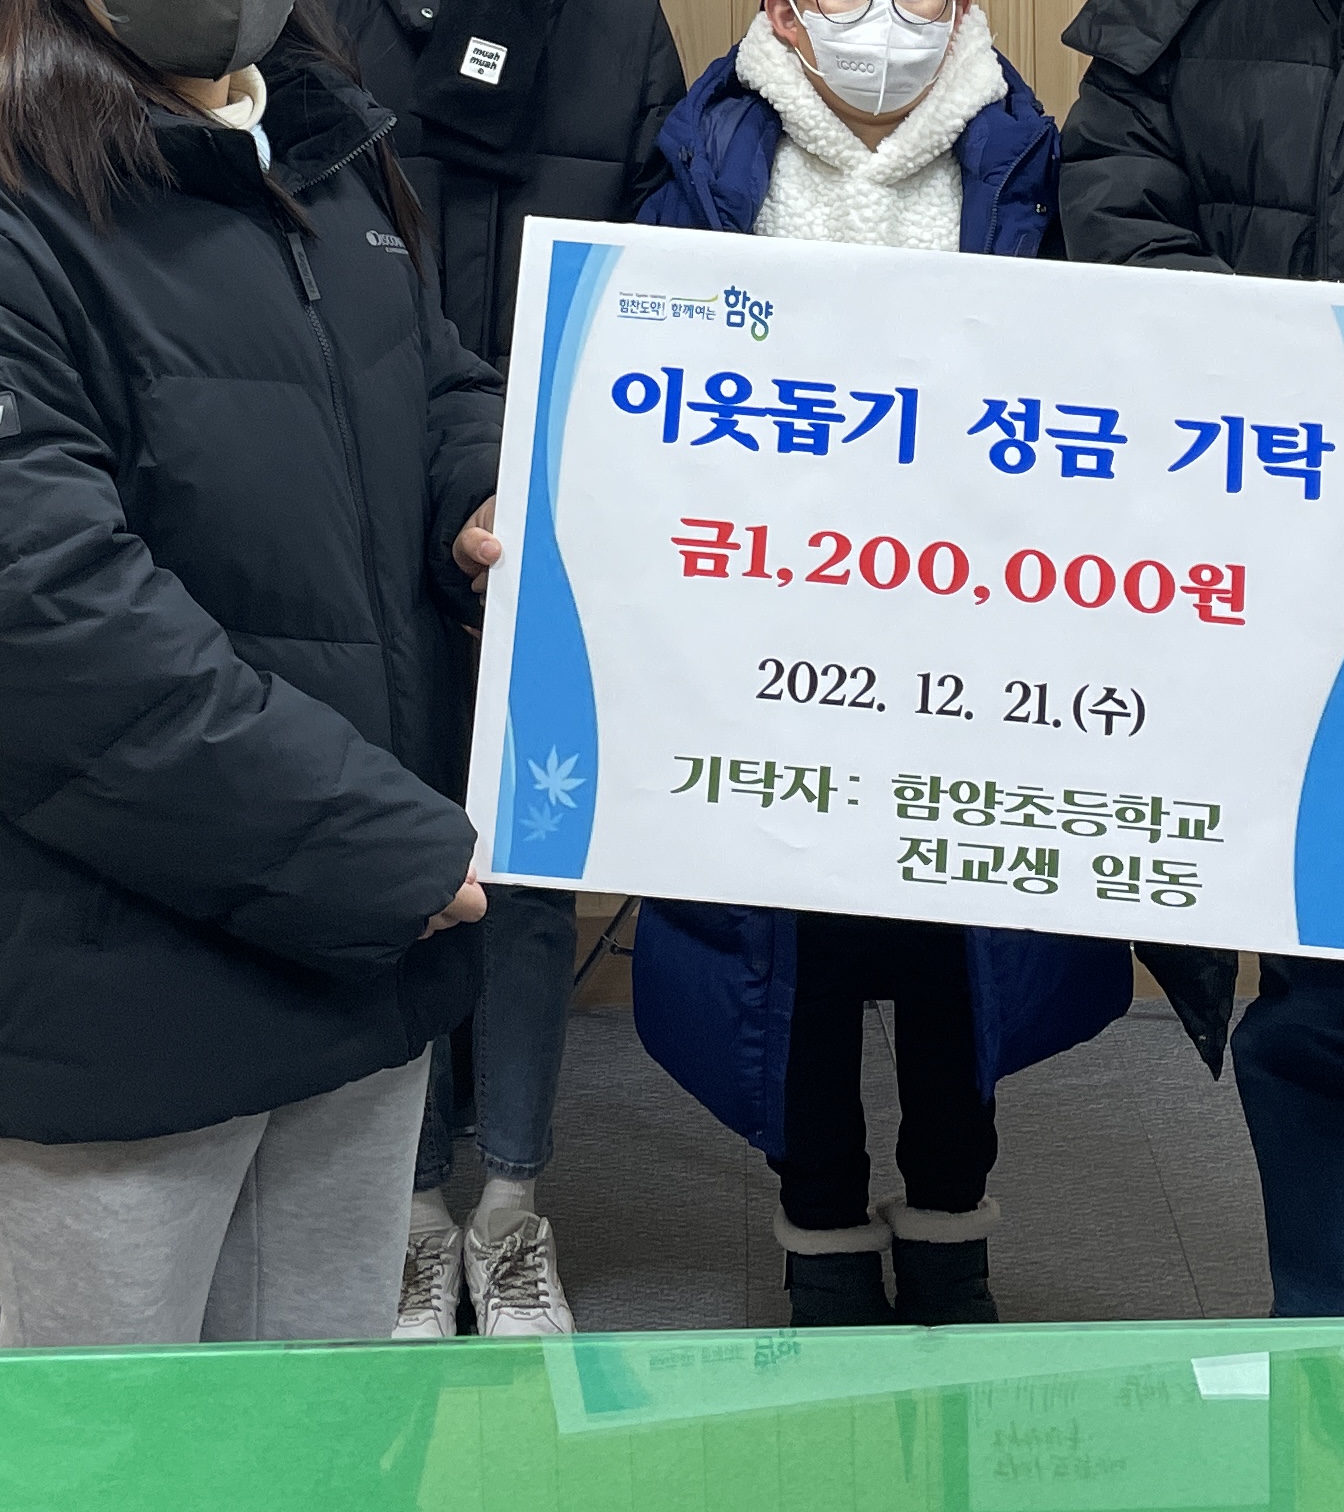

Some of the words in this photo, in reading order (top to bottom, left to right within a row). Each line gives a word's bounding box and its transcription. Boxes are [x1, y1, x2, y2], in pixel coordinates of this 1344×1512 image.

[619, 298, 666, 317] 힘찬도약!
[671, 302, 717, 321] 함께여는
[723, 285, 774, 342] 함양
[611, 366, 919, 465] 이웃돕기
[966, 397, 1128, 480] 성금
[1167, 414, 1336, 501] 기탁
[670, 517, 1247, 626] 금1,200,000원
[755, 657, 887, 713] 2022.
[914, 671, 975, 721] 12.
[1003, 679, 1147, 738] 21.(수)
[891, 772, 1225, 844] 함양초등학교
[896, 835, 1061, 896] 전교생
[1091, 852, 1204, 909] 일동
